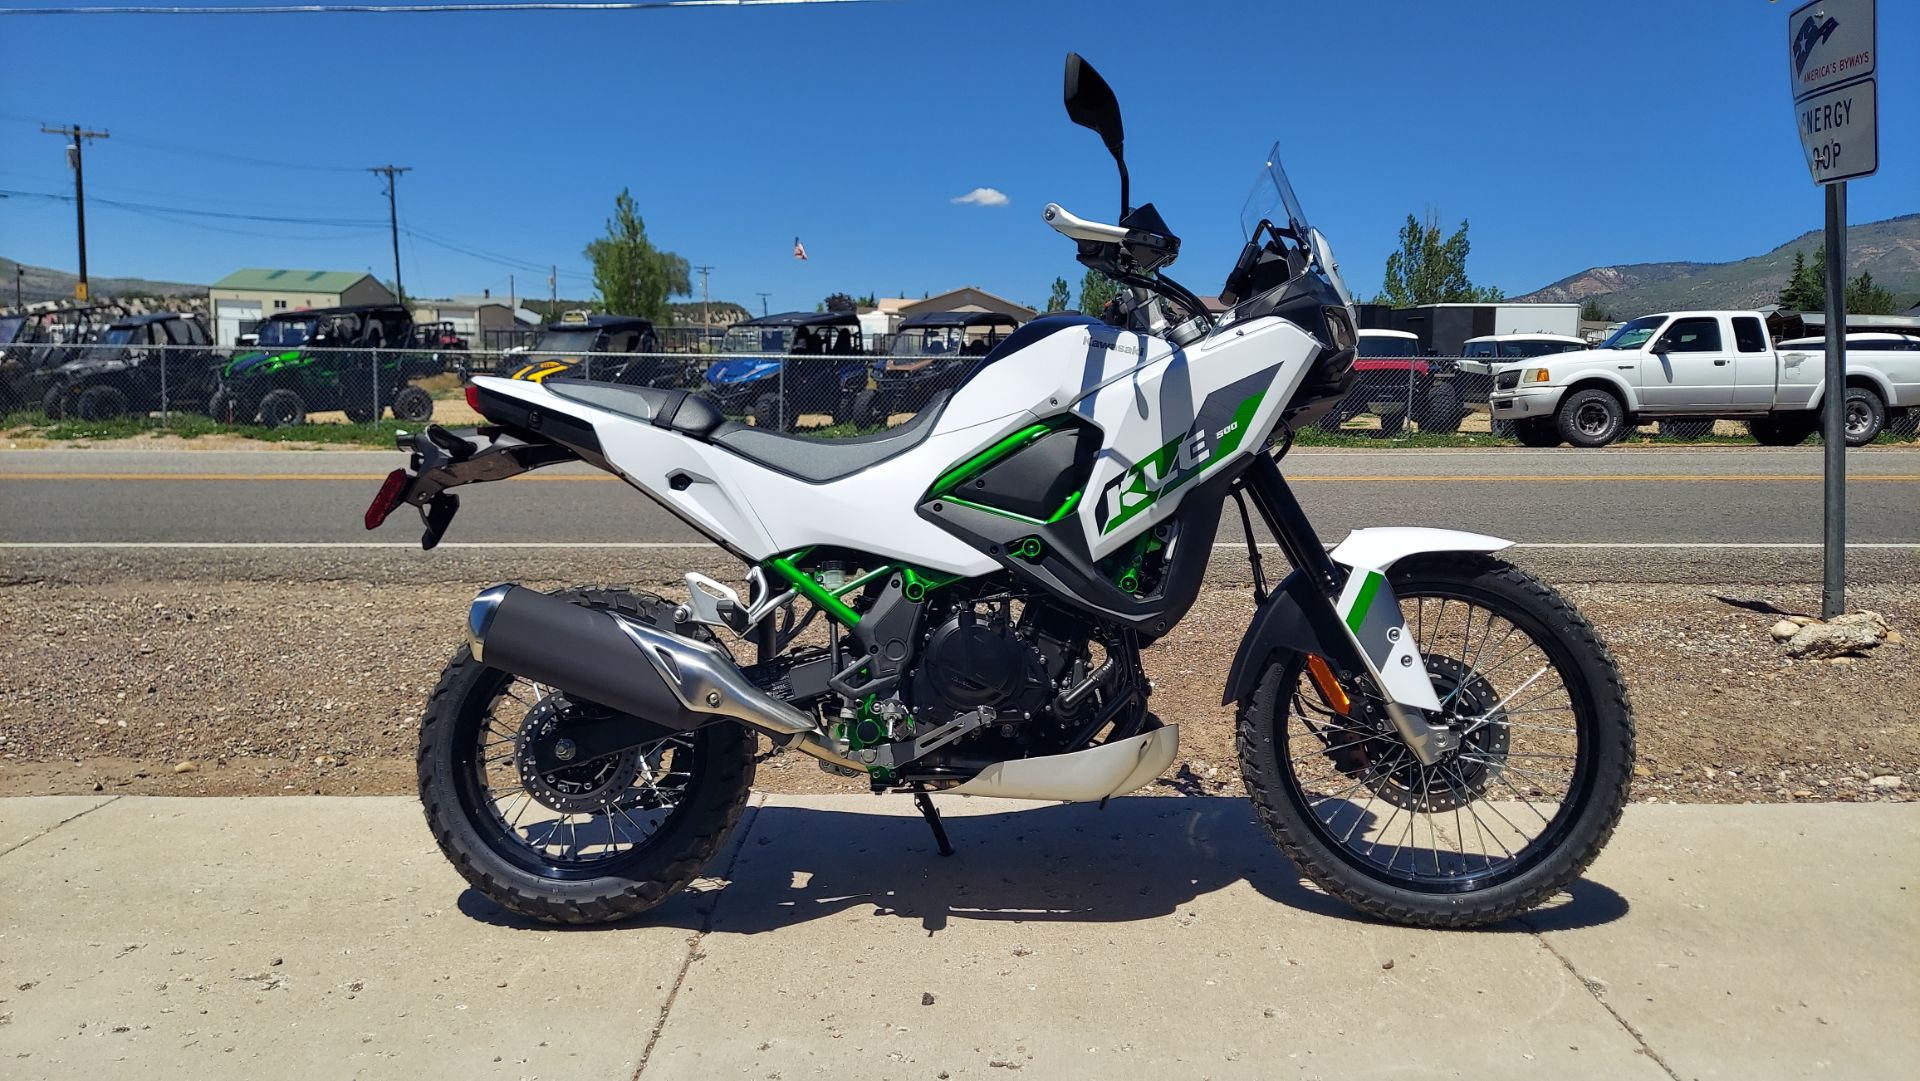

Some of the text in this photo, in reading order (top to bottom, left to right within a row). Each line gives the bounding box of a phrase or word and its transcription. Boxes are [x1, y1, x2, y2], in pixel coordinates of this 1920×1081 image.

[1804, 51, 1869, 83] AMERICA'S BYWAYS
[1811, 142, 1841, 170] OOP
[1083, 336, 1144, 356] Kawasaki
[1106, 421, 1238, 517] KLE 500
